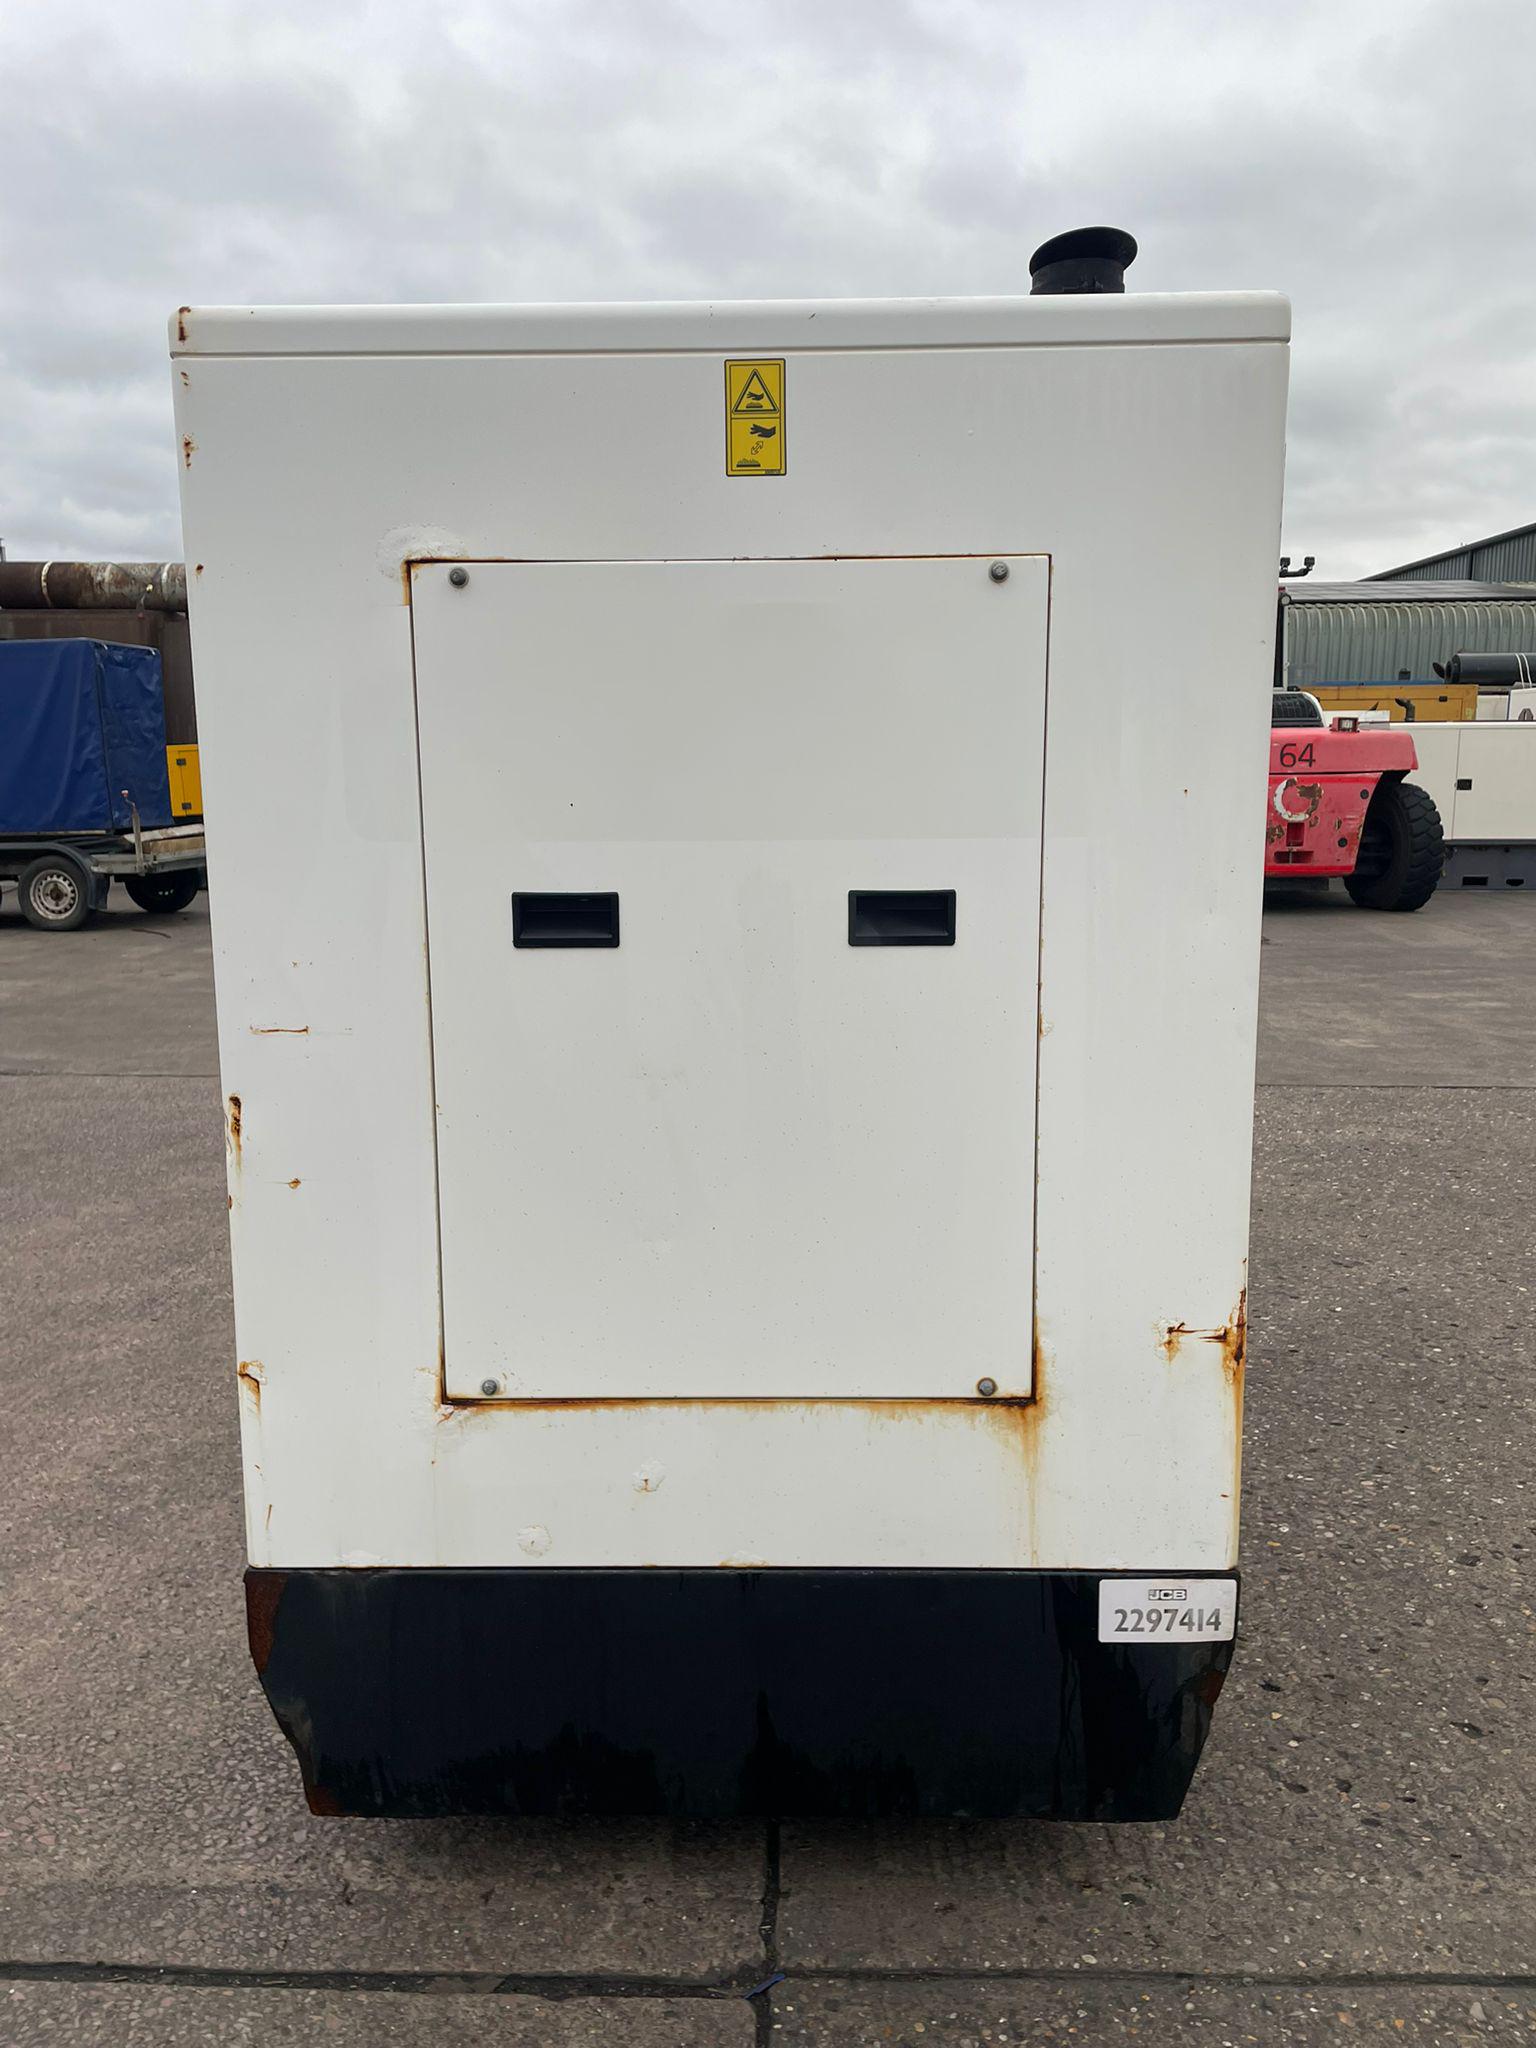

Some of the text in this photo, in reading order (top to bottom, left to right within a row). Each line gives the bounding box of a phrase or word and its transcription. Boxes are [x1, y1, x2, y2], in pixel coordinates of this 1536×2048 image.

[1280, 743, 1316, 768] 64
[1149, 1589, 1186, 1600] JCB
[1114, 1608, 1221, 1632] 2297414
